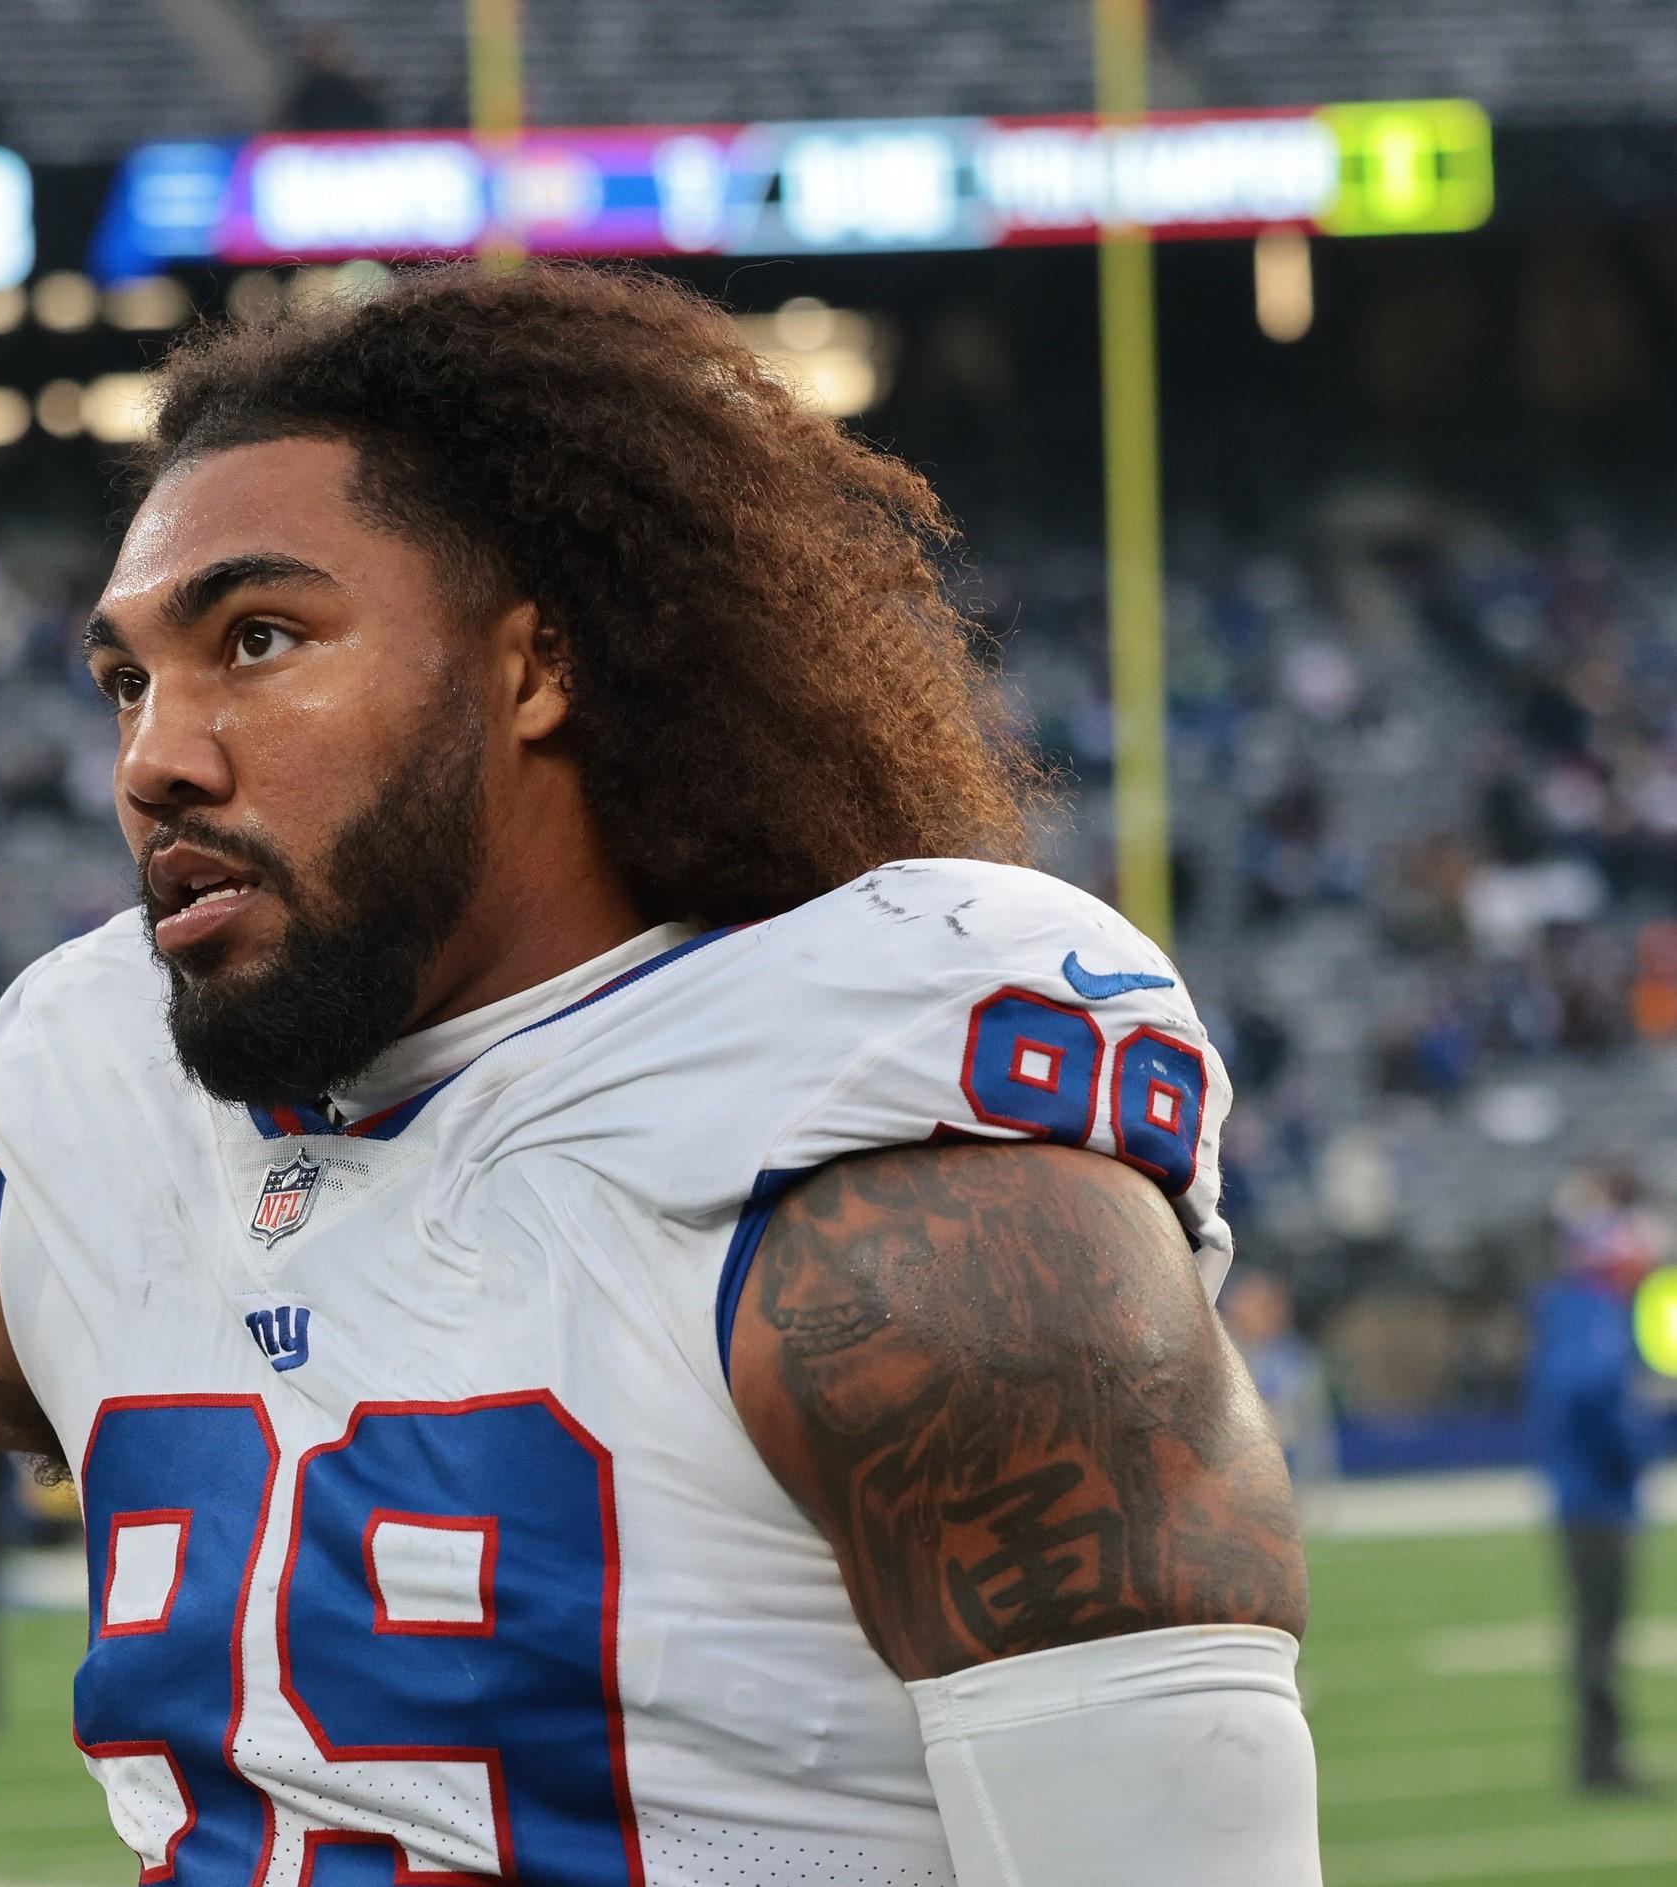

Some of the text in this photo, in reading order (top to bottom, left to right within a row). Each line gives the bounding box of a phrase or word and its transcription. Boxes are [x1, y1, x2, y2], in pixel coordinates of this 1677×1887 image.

[926, 986, 1208, 1197] 99
[257, 1192, 301, 1229] NFL
[73, 1388, 644, 1887] 99
